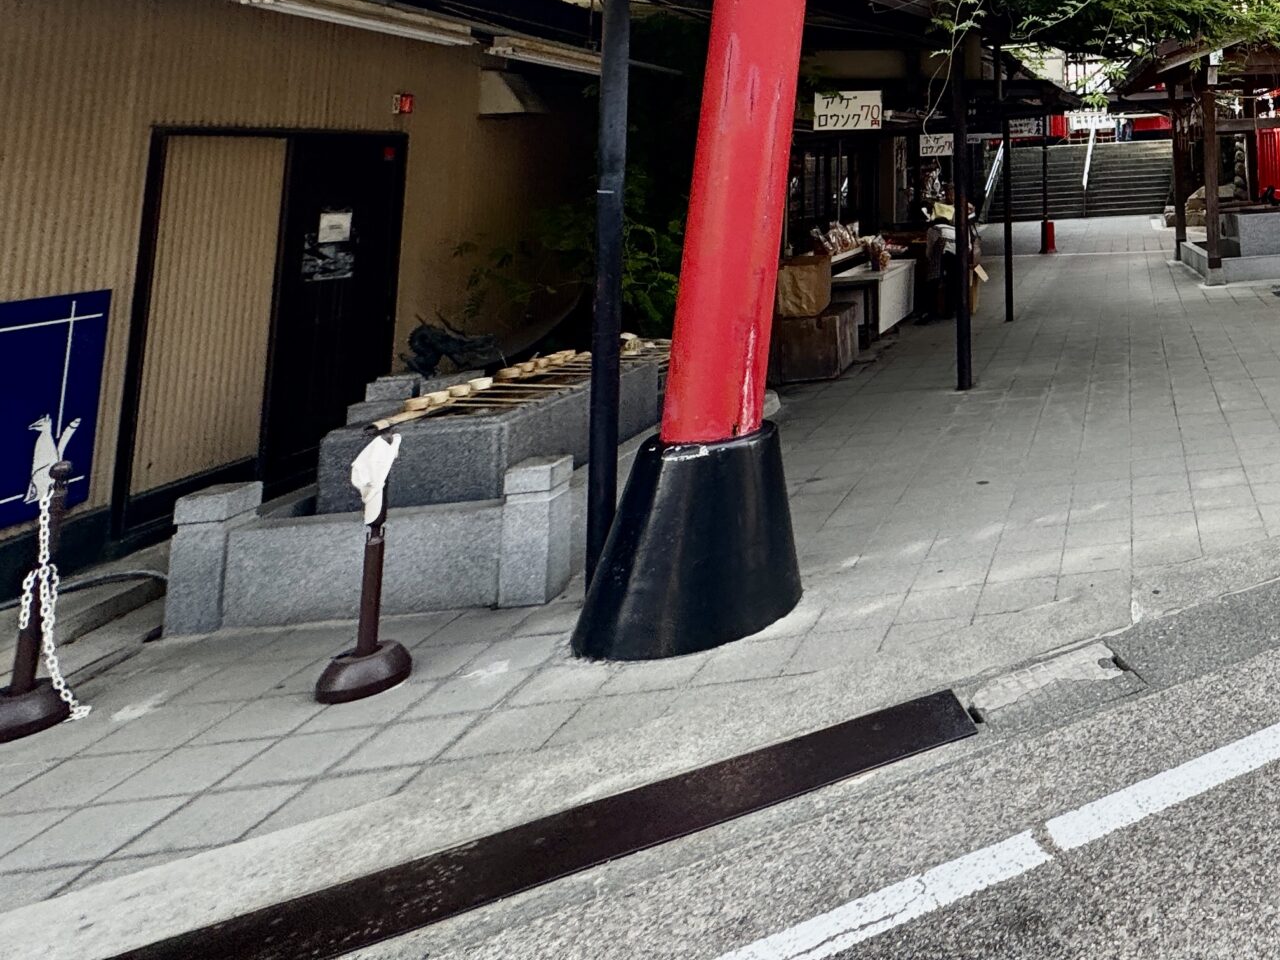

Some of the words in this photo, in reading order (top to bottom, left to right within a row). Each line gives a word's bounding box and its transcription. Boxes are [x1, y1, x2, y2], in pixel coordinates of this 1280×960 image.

[821, 95, 857, 110] アゲ
[860, 104, 880, 120] 70
[818, 113, 861, 128] ロウソク
[870, 119, 880, 128] 円
